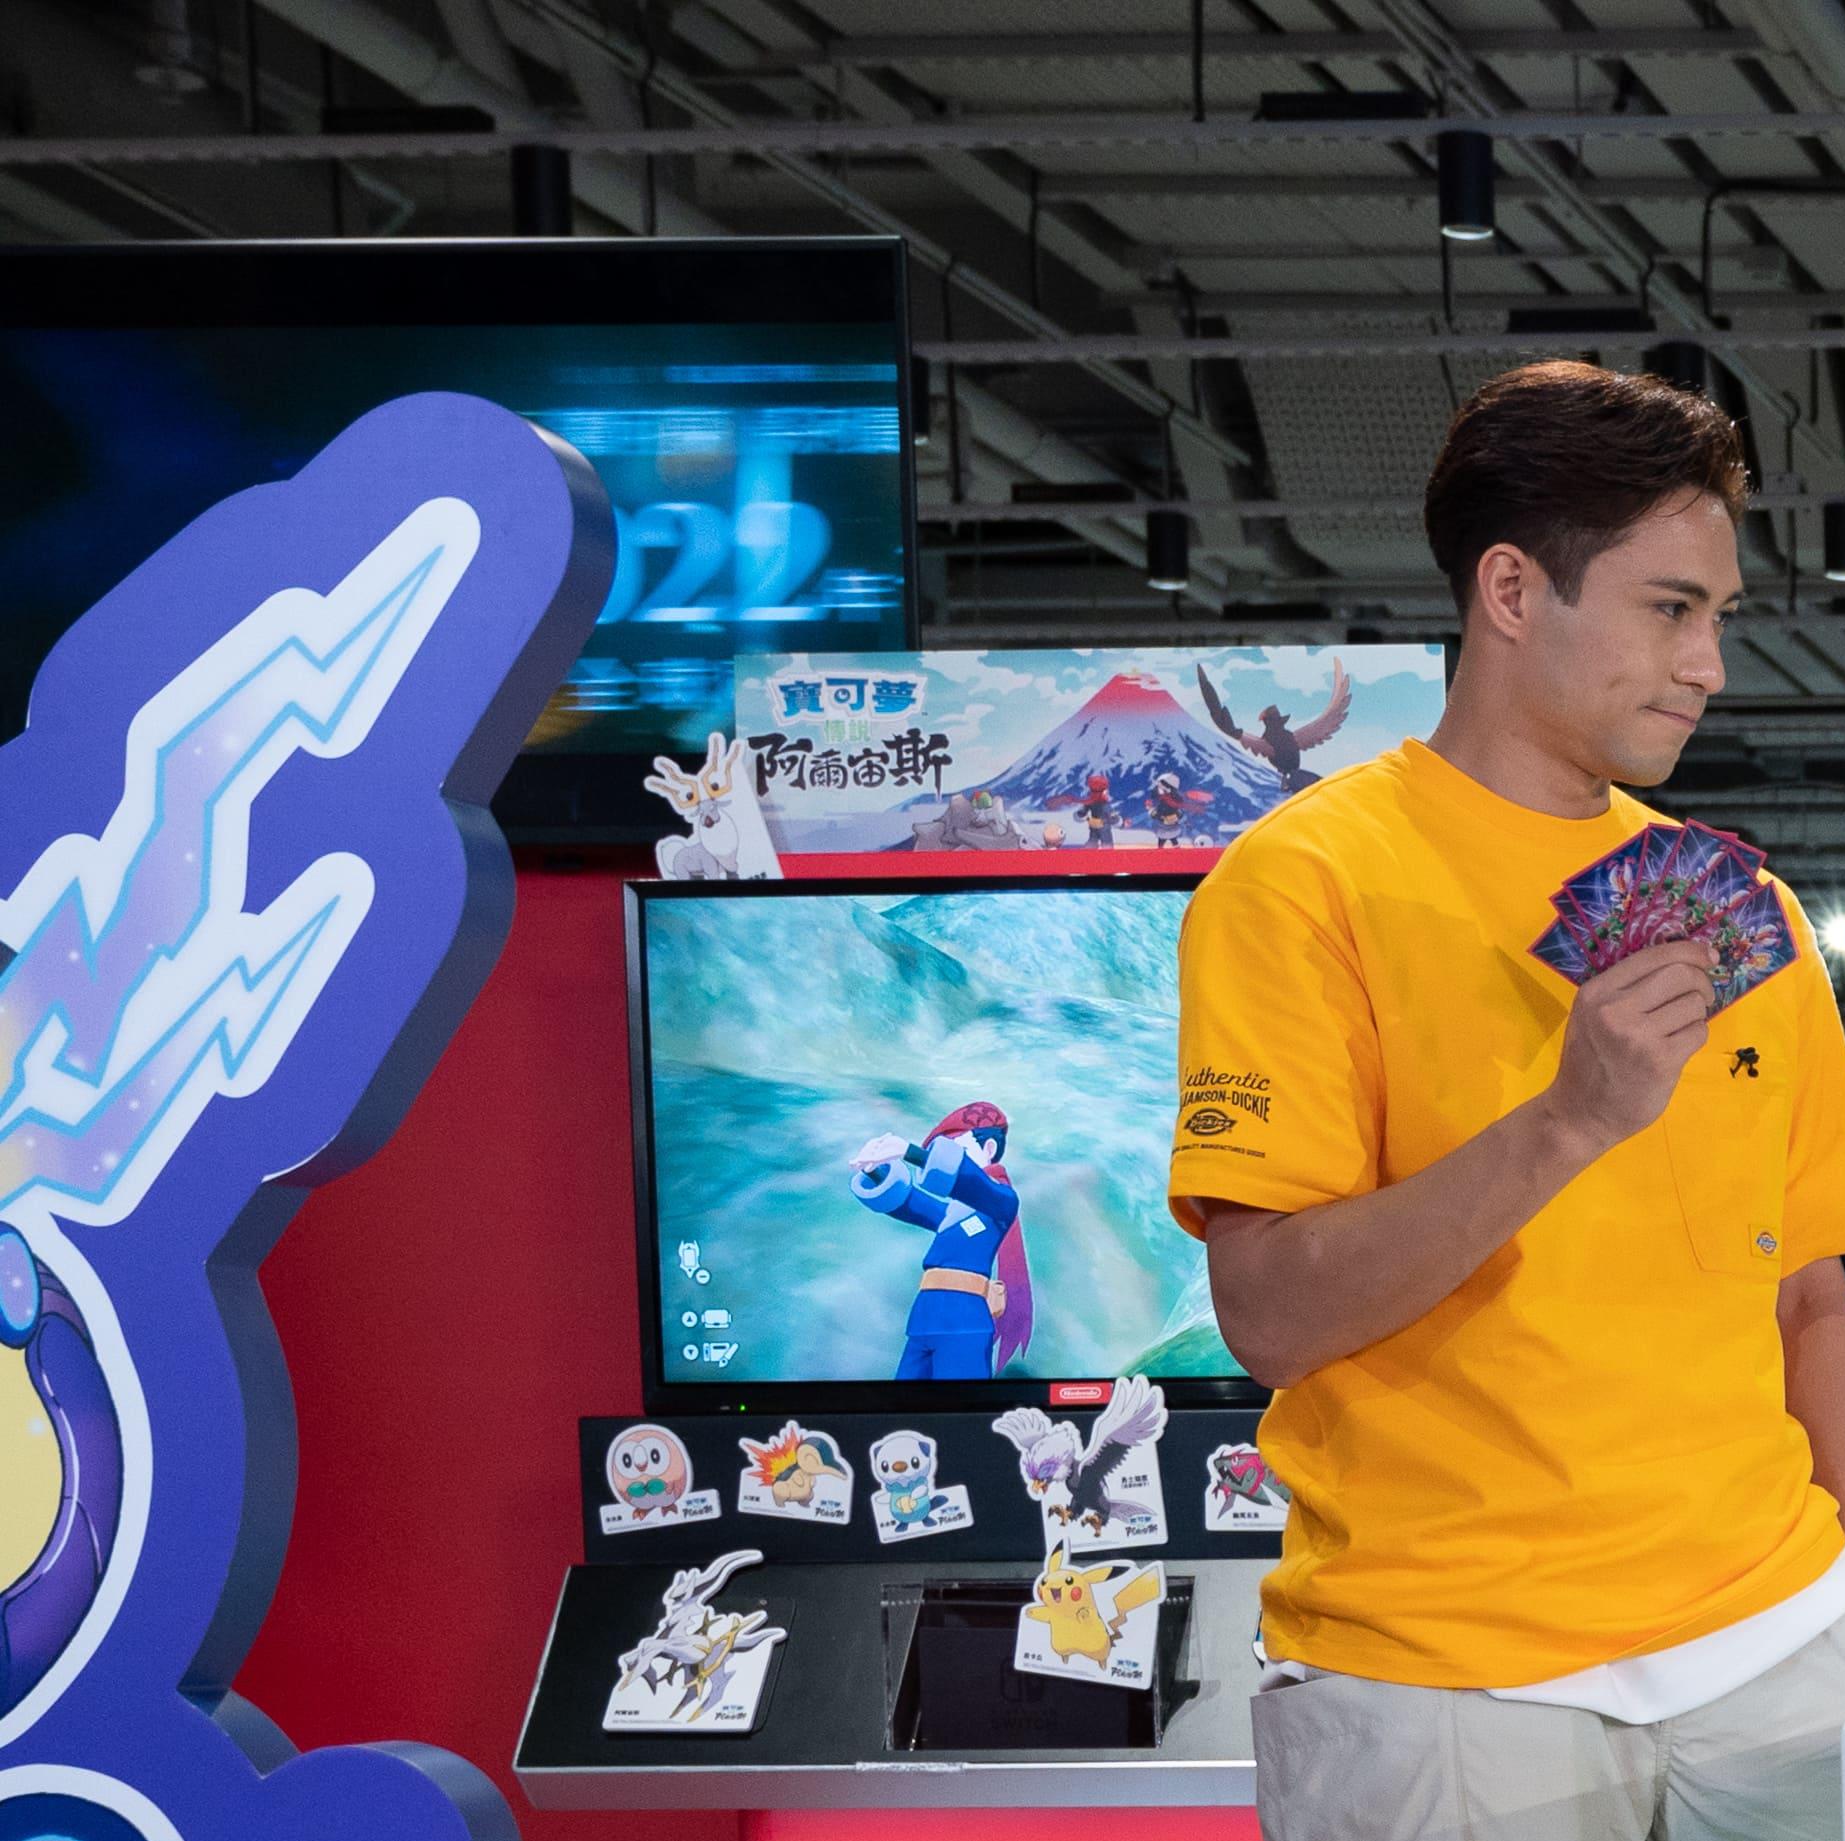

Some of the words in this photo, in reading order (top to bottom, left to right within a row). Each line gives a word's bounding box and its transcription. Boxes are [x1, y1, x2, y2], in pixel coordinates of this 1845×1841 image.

[778, 677, 918, 717] 寶可夢
[748, 729, 952, 799] 阿爾宙斯
